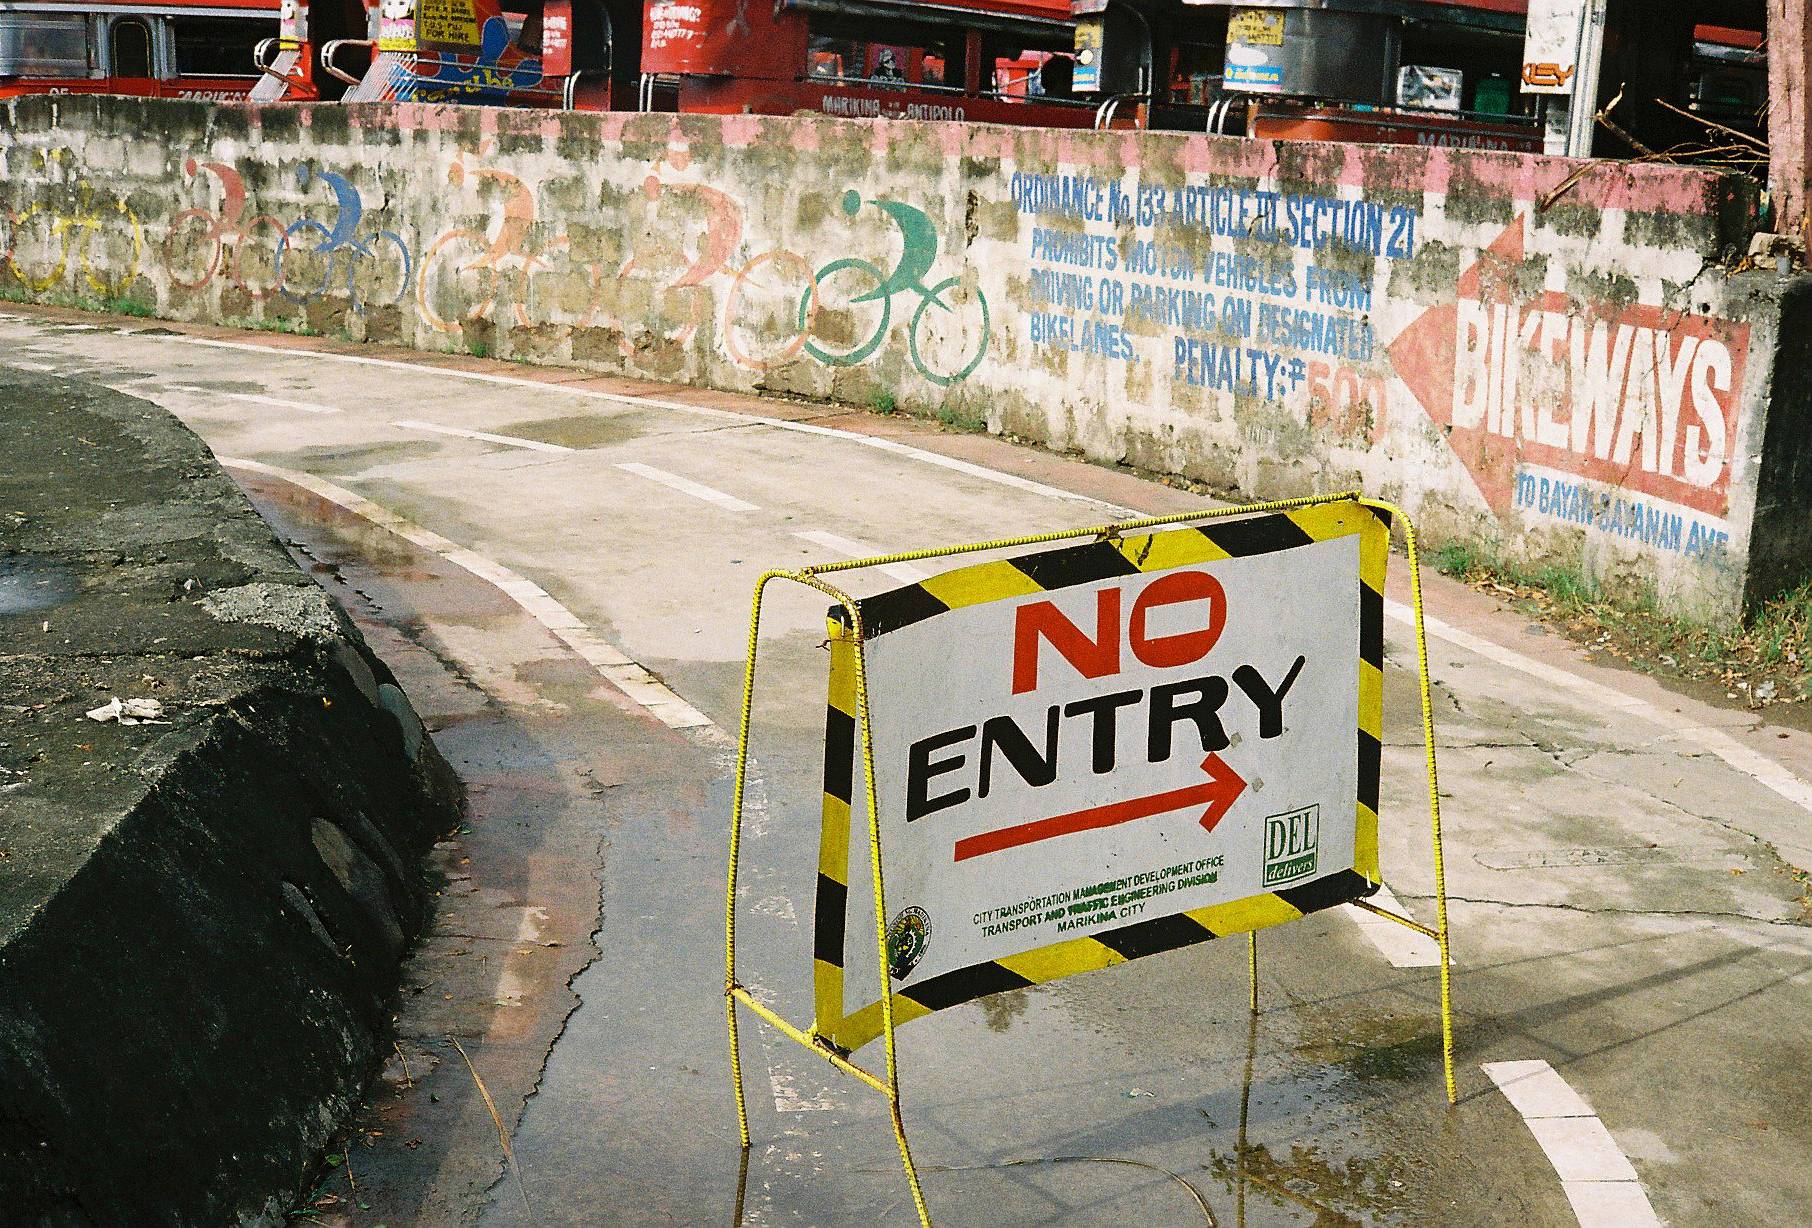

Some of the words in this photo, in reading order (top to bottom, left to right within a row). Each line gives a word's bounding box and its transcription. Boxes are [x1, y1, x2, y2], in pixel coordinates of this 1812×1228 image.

[1011, 171, 1103, 222] ORDINANCE
[1172, 184, 1252, 239] ARTICLE
[1286, 193, 1383, 257] SECTION
[1386, 204, 1418, 259] 21
[1031, 227, 1118, 271] PROHIBITS
[1124, 240, 1195, 282] MOTOR
[1203, 251, 1298, 298] VEHICLES
[1306, 265, 1374, 312] FROM
[1031, 268, 1093, 312] DRIVING
[1099, 277, 1124, 316] OR
[1130, 282, 1217, 332] PARKING
[1222, 296, 1252, 339] ON
[1451, 298, 1732, 487] BIKEWAYS
[1517, 471, 1536, 508] TO
[1011, 570, 1228, 696] NO
[905, 654, 1306, 823] ENTRY
[1267, 811, 1316, 861] DEL
[1268, 861, 1313, 881] delivers
[972, 910, 993, 925] CITY
[994, 890, 1071, 921] TRANSPORTATION
[1072, 876, 1134, 901] MANAGEMENT
[1133, 861, 1195, 887] DEVELOPMENT
[1195, 854, 1225, 872] OFFICE
[981, 913, 1044, 938] TRANSPORT
[1044, 907, 1066, 923] AND
[1067, 897, 1109, 918] TRAFFIC
[1110, 881, 1176, 907] ENGINEERING
[1177, 871, 1219, 892] DIVISION
[1057, 910, 1118, 933] MARIKINA
[1119, 902, 1146, 918] CITY
